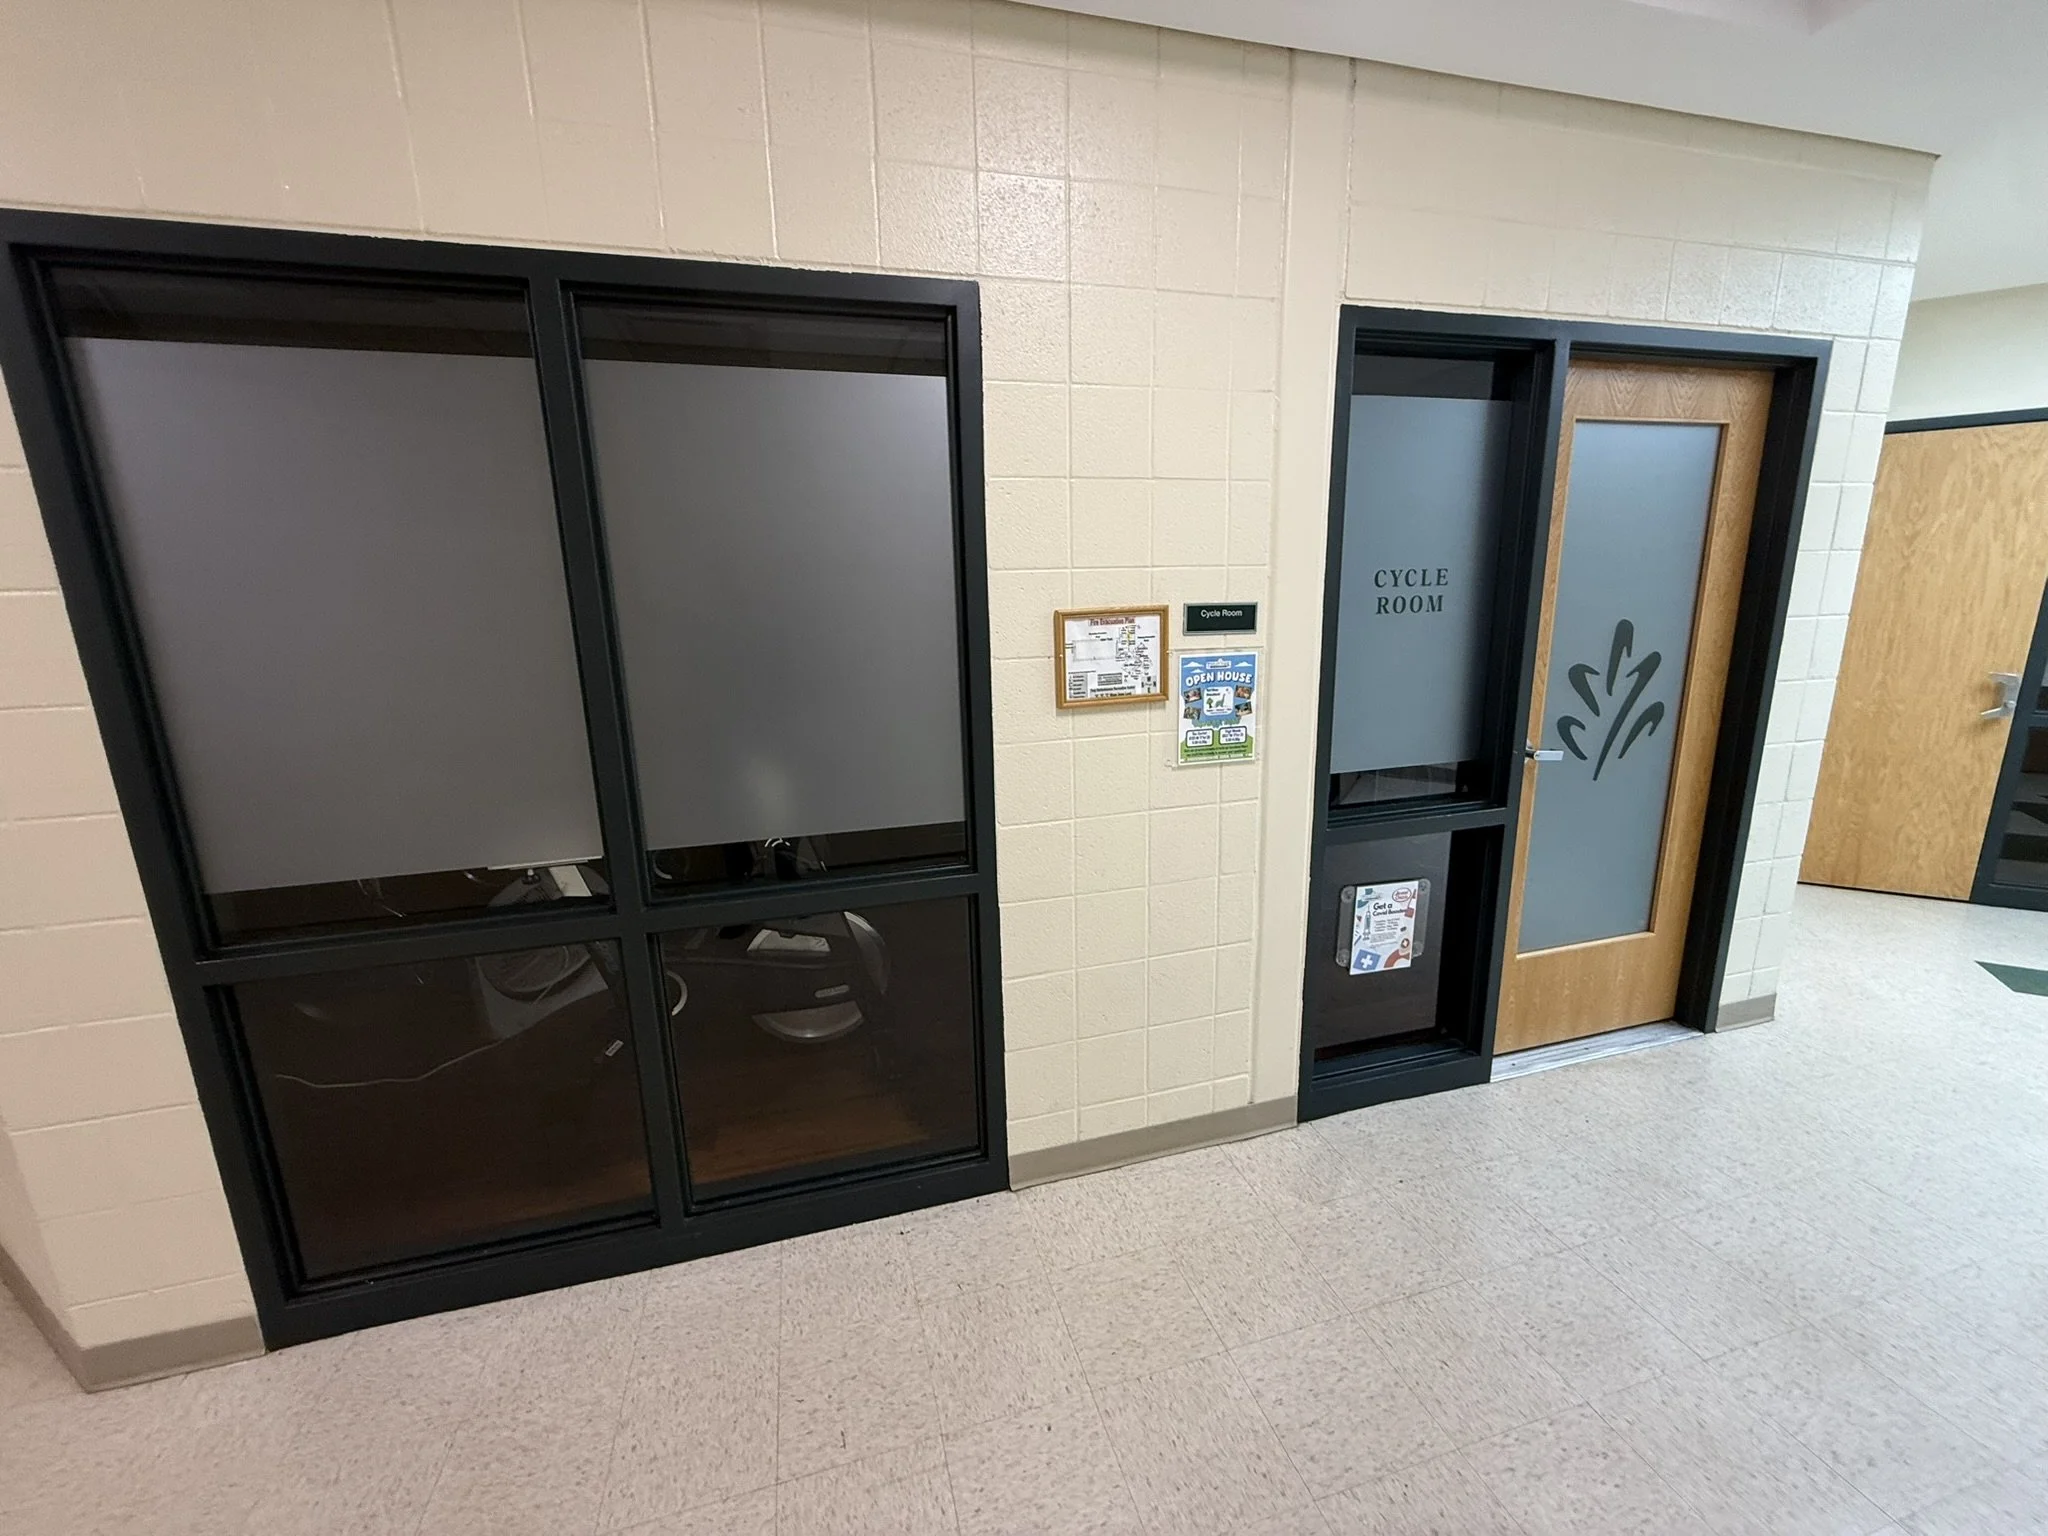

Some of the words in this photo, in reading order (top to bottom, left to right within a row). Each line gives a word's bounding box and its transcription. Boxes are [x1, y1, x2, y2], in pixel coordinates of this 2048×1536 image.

[1373, 568, 1449, 588] CYCLE
[1375, 594, 1443, 614] ROOM
[1200, 609, 1221, 618] Cycle
[1222, 608, 1243, 617] Room
[1185, 671, 1214, 686] OPEN
[1217, 671, 1252, 683] HOUSE
[1373, 902, 1386, 910] Get
